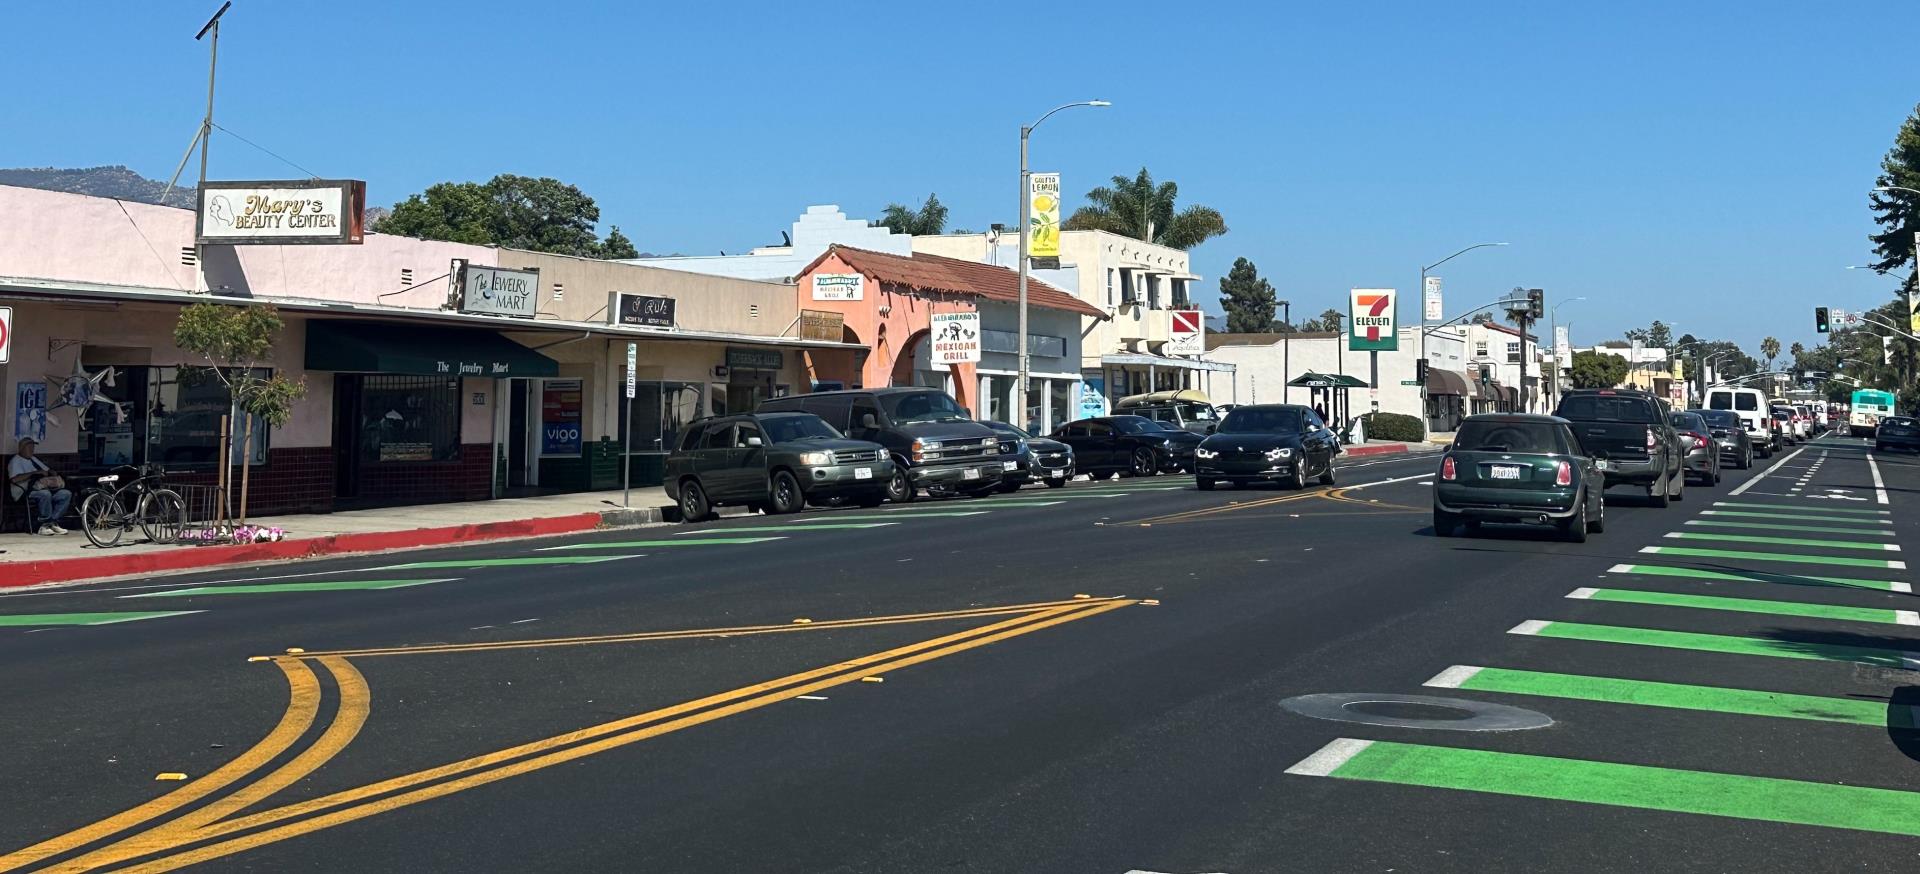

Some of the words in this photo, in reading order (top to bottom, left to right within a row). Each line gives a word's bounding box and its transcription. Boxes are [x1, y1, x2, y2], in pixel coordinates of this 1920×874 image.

[1032, 183, 1059, 192] LEMON
[244, 195, 323, 216] Mary's
[235, 214, 284, 229] BEAUTY
[288, 213, 337, 228] CENTER
[474, 273, 488, 295] The
[487, 271, 530, 297] JEWELRY
[496, 294, 527, 310] MART
[935, 342, 977, 351] MEXICAN
[943, 352, 969, 360] GRILL
[437, 361, 450, 373] The
[19, 388, 45, 409] ICE
[547, 425, 579, 443] vigo
